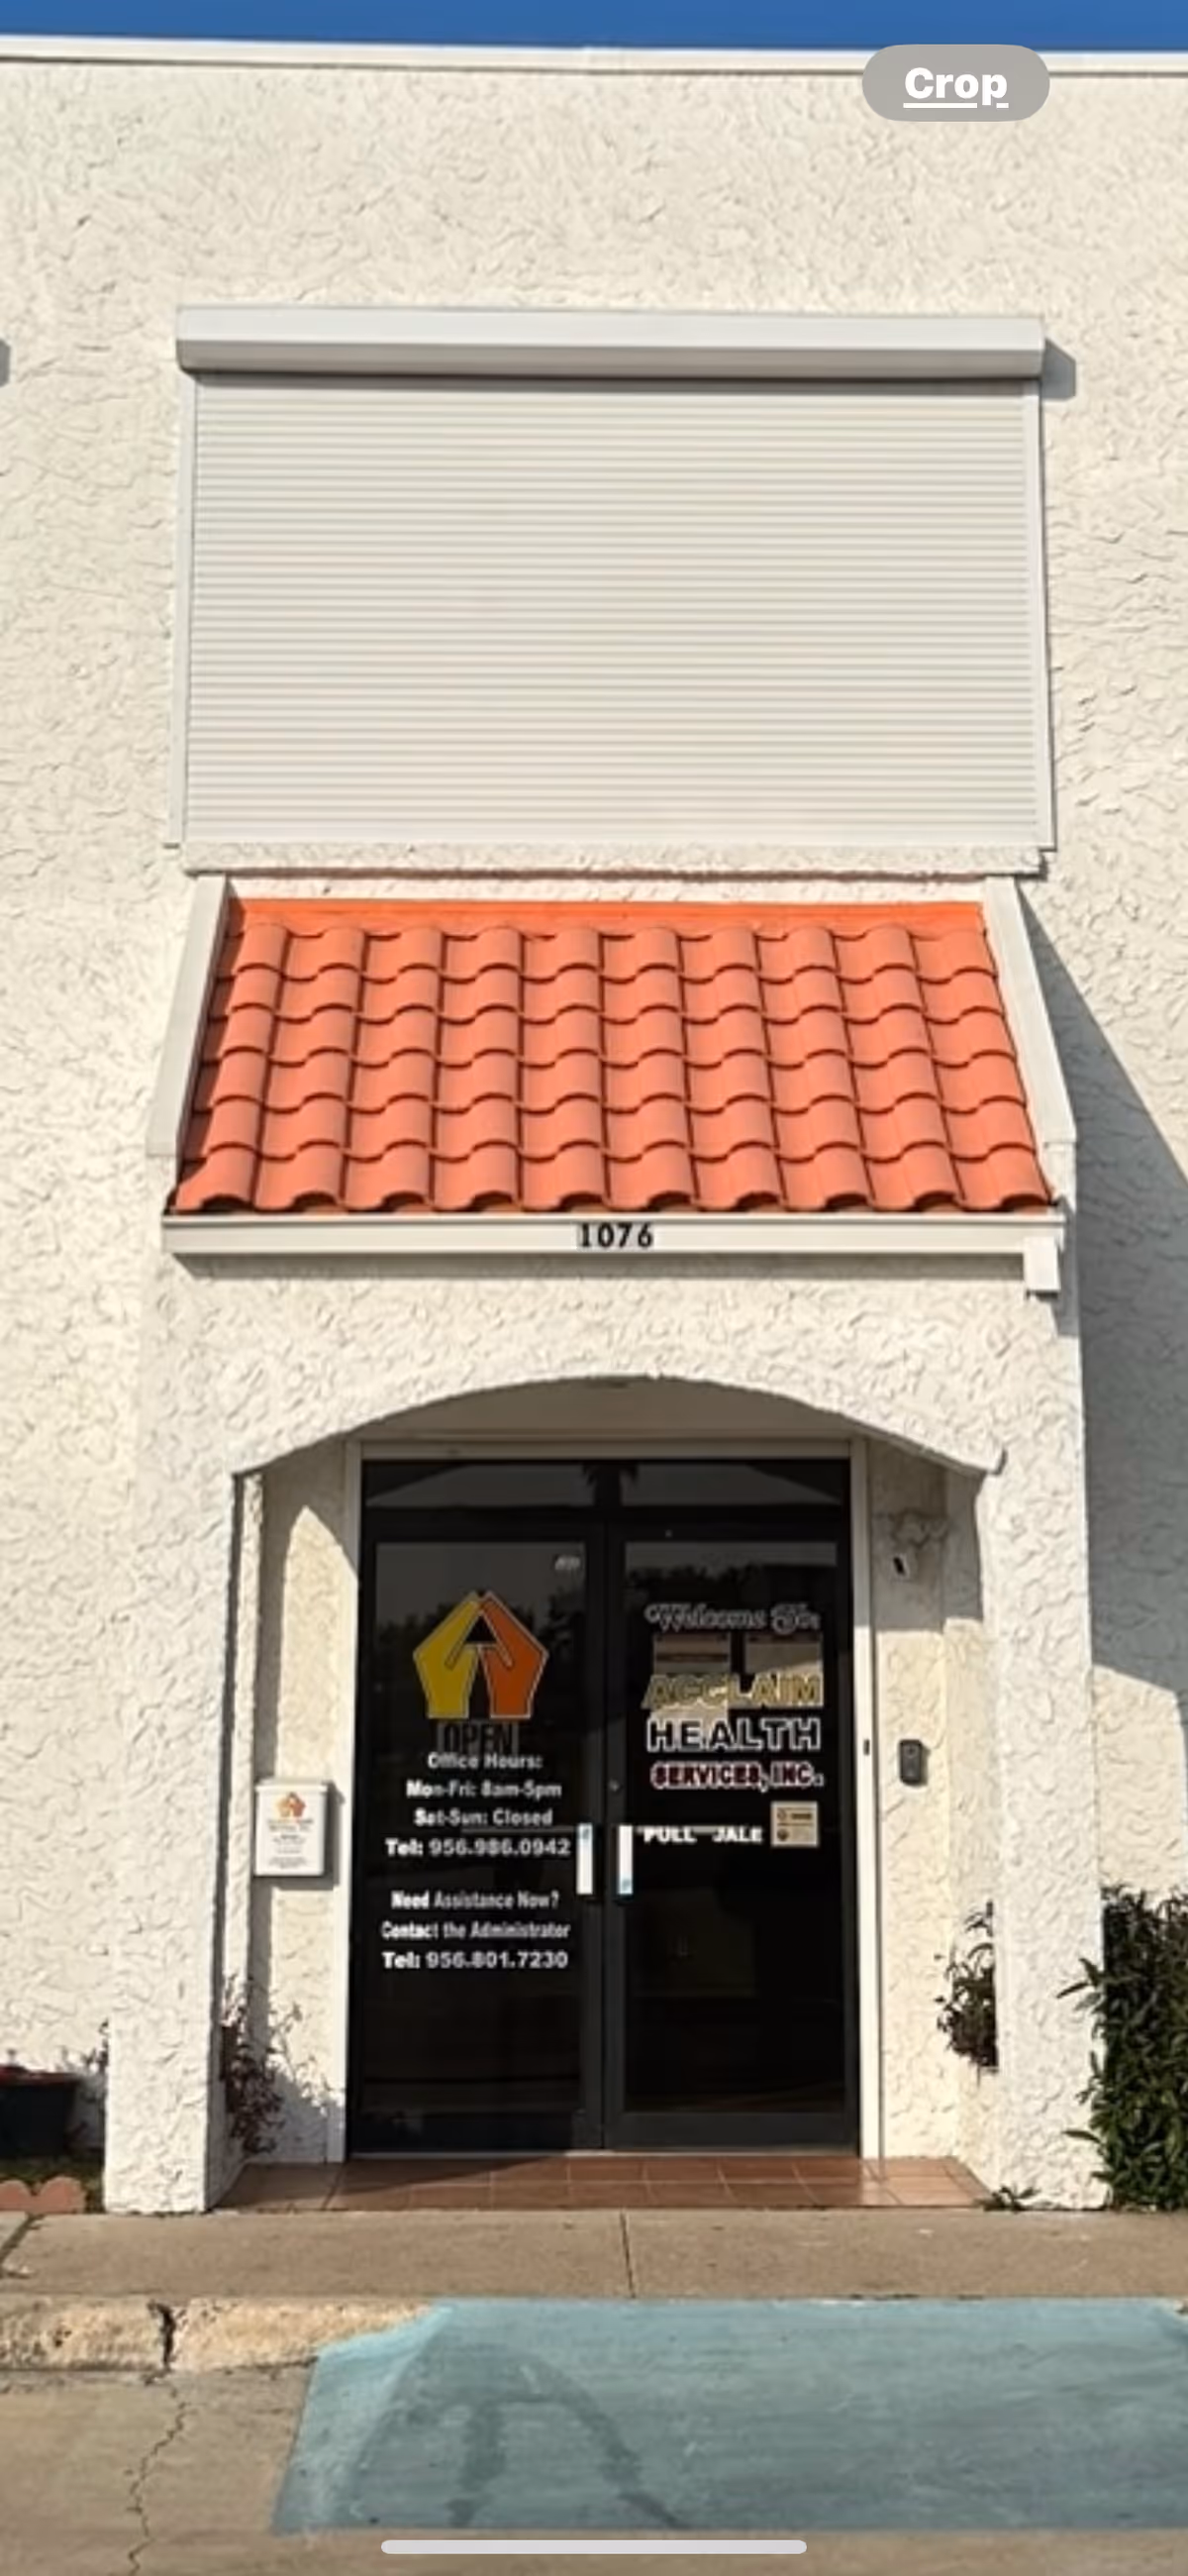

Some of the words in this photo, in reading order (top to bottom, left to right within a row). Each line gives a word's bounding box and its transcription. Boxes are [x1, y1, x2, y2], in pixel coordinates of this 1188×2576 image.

[579, 1221, 653, 1248] 1076
[644, 1603, 765, 1631] Welcome
[641, 1673, 824, 1709] ACCLAIM
[646, 1716, 822, 1753] HEALTH
[427, 1752, 479, 1769] Office
[483, 1752, 544, 1769] Hours:
[649, 1761, 768, 1793] SERVICES,
[769, 1760, 825, 1789] INC.
[406, 1780, 475, 1798] Mon-Fri:
[480, 1780, 562, 1801] 8am-5pm
[414, 1807, 487, 1827] Sat-Sun:
[492, 1807, 553, 1826] Closed
[644, 1826, 697, 1844] PULL
[712, 1826, 763, 1844] JALE
[385, 1837, 424, 1857] Tel:
[428, 1837, 572, 1857] 956.986.0942
[390, 1890, 430, 1909] Need
[435, 1891, 514, 1909] Assistance
[517, 1890, 560, 1909] Now?
[381, 1920, 438, 1940] Contact
[444, 1920, 467, 1939] the
[470, 1921, 571, 1939] Administrator
[382, 1951, 421, 1969] Tel:
[426, 1951, 568, 1970] 956.801.7230
